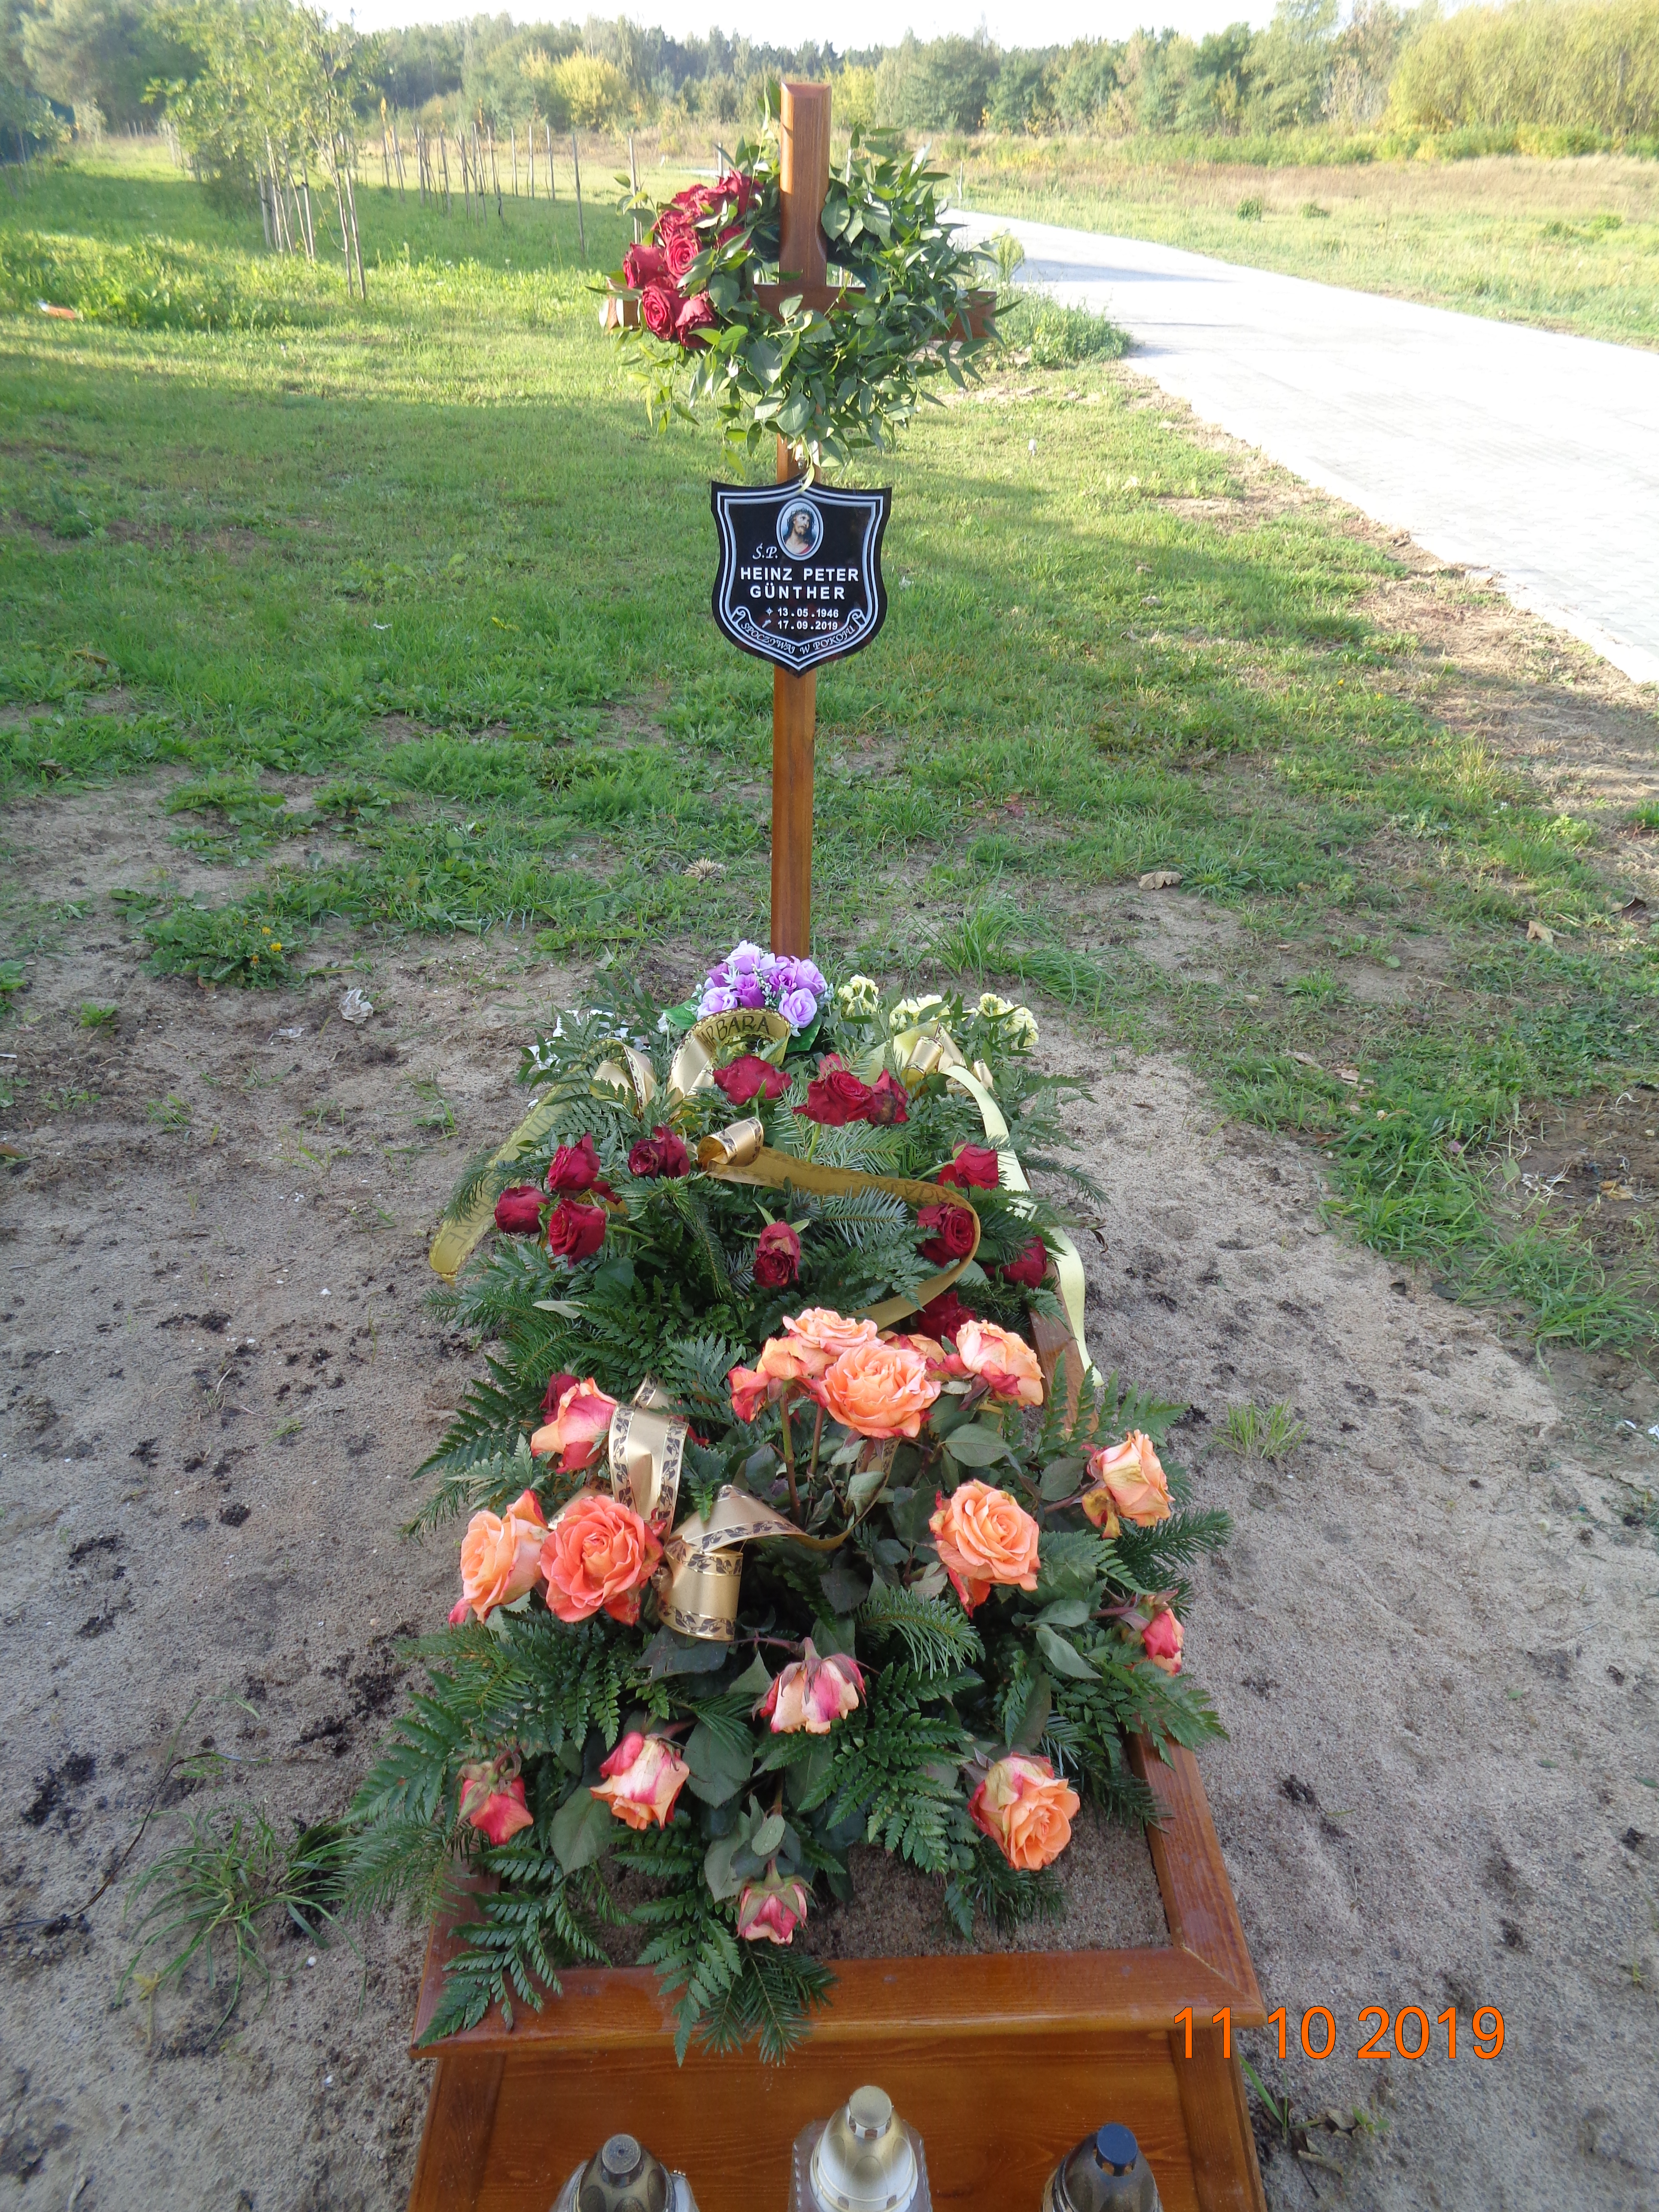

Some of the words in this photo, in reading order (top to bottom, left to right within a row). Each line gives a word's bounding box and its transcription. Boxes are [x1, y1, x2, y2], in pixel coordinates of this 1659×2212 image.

[741, 567, 793, 581] HEINZ
[803, 568, 859, 582] PETER
[750, 582, 845, 600] GÜNTHER
[741, 622, 795, 654] SPOCZYWAJ
[799, 644, 811, 655] W
[813, 625, 856, 650] POKOJU
